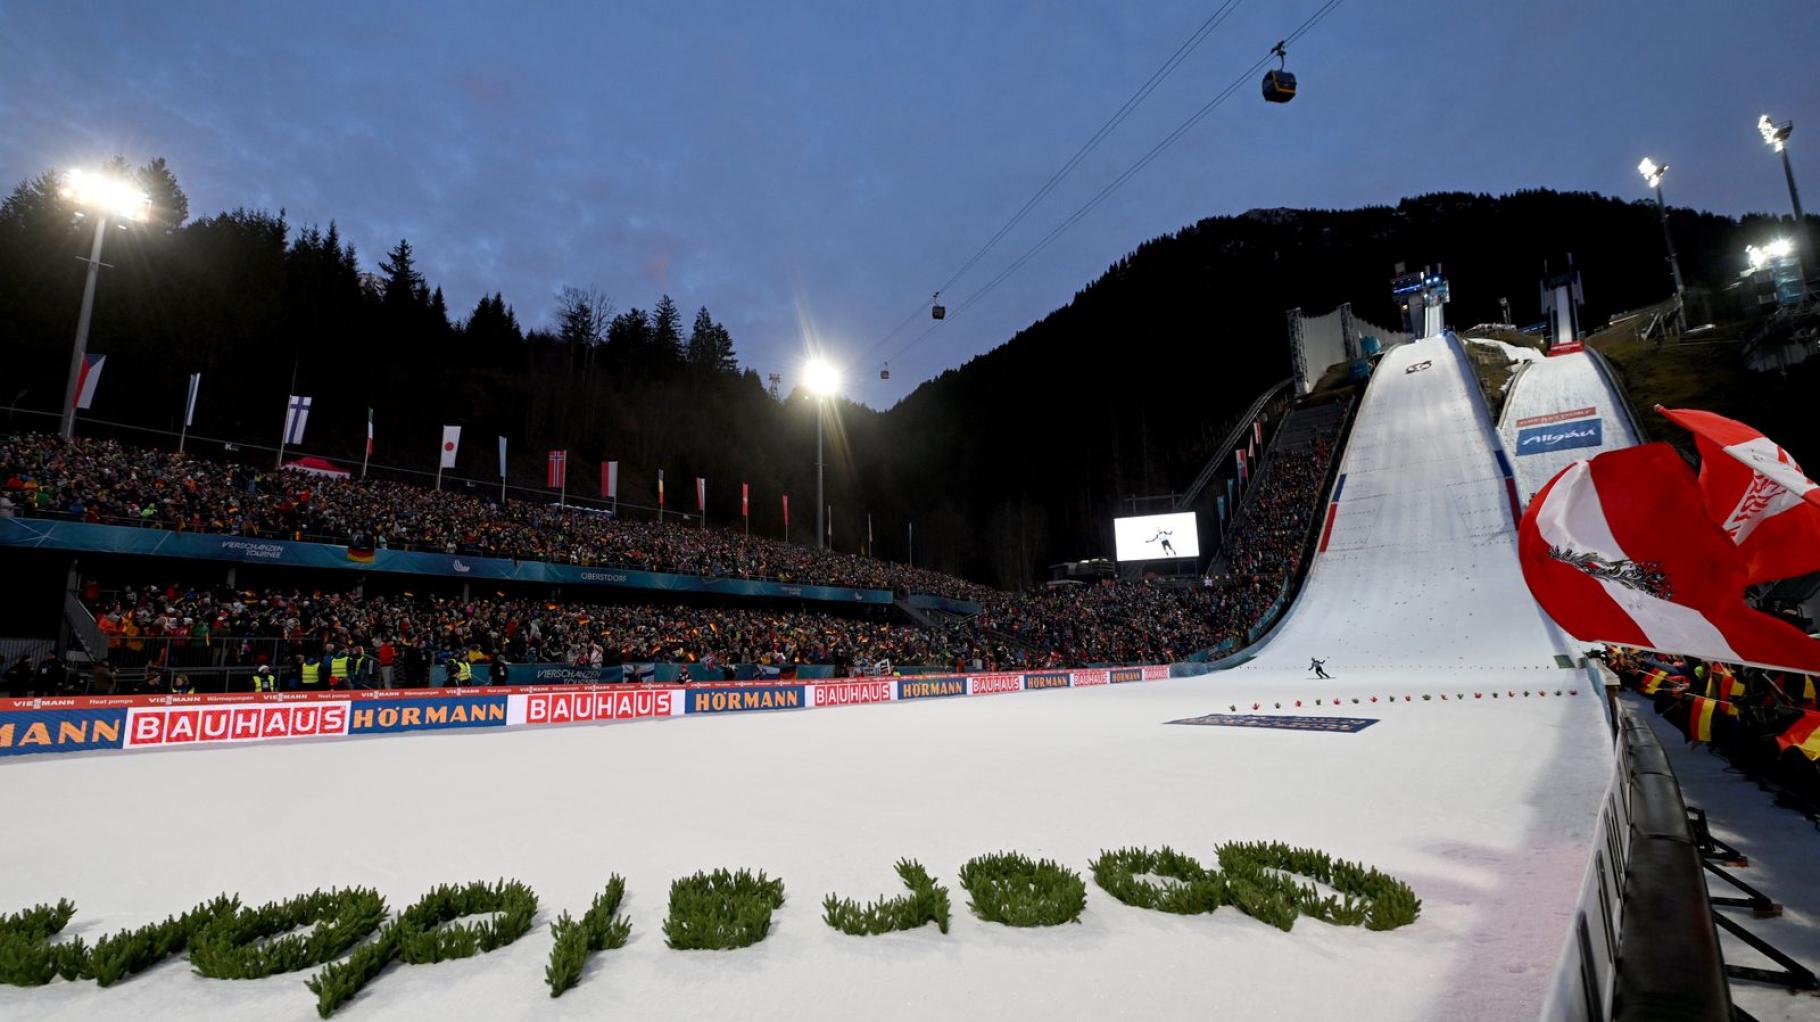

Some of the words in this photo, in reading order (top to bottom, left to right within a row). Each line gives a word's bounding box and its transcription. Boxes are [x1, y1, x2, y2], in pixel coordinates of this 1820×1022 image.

[222, 541, 284, 552] VIERSCHANZEN
[246, 550, 281, 559] TOURNEE
[580, 572, 628, 582] OBERSTDORF
[537, 668, 601, 679] VIERSCHANZEN
[1073, 672, 1108, 686] BAUHAUS
[903, 681, 963, 697] HÖRMANN
[973, 677, 1020, 693] BAUHAUS
[695, 690, 798, 712] HÖRMANN
[816, 683, 890, 704] BAUHAUS
[530, 694, 670, 720] BAUHAUS
[136, 707, 343, 740] BAUHAUS
[353, 703, 506, 729] HÖRMANN
